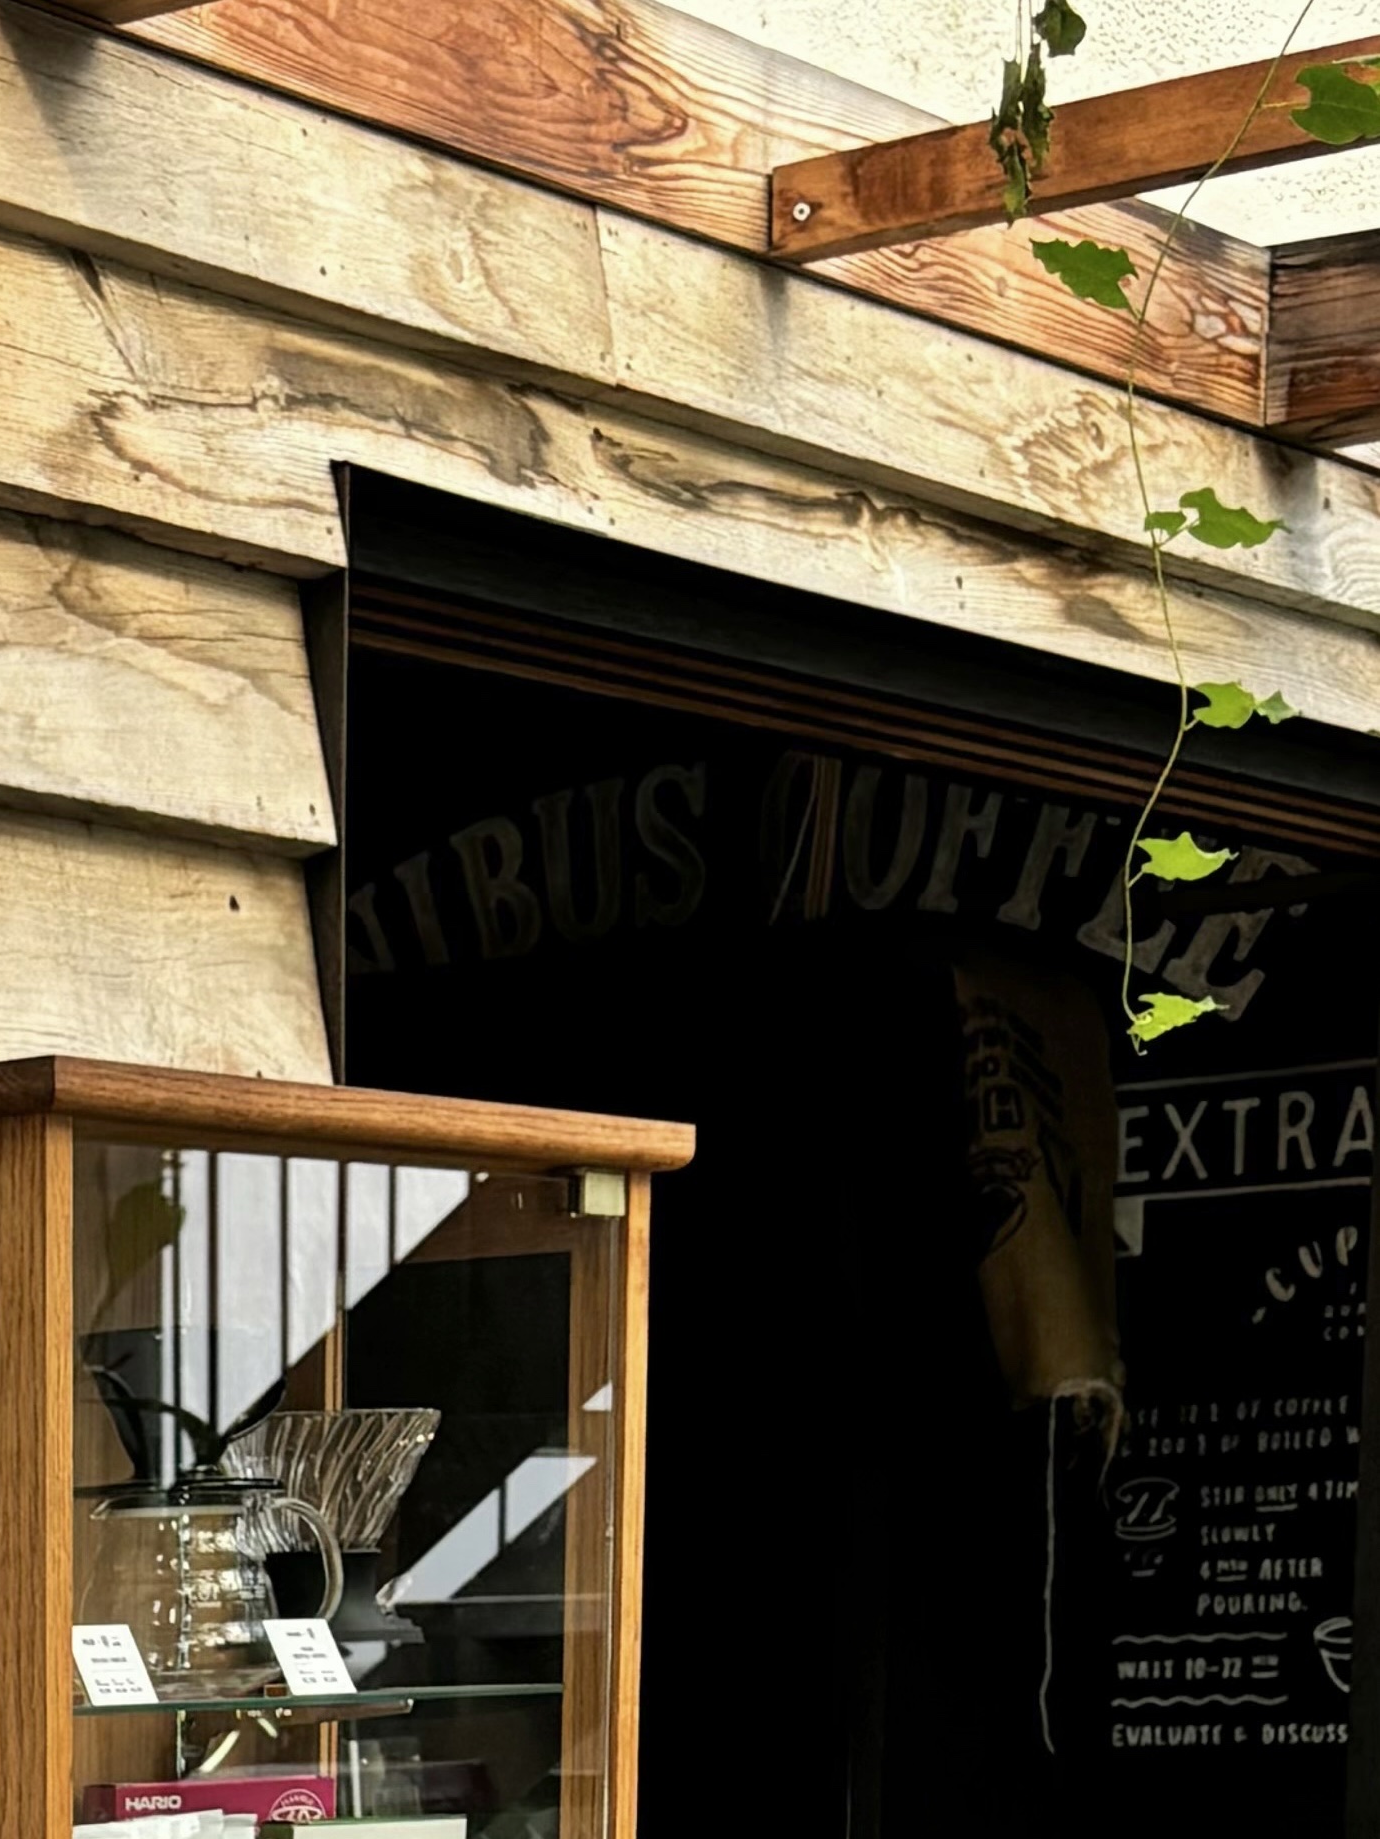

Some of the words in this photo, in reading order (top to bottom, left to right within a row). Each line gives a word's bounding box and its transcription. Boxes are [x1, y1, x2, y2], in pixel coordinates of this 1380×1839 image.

[1116, 1085, 1375, 1183] EXTRA
[1264, 1225, 1359, 1302] CUP
[1273, 1394, 1350, 1419] COFFEE
[1200, 1522, 1277, 1547] SLOWLY
[1258, 1556, 1324, 1582] AFTER
[1116, 1658, 1175, 1680] WAIT
[1111, 1722, 1223, 1748] EVALUATE
[1260, 1721, 1350, 1746] DISCUSS
[124, 1794, 182, 1812] HARIO
